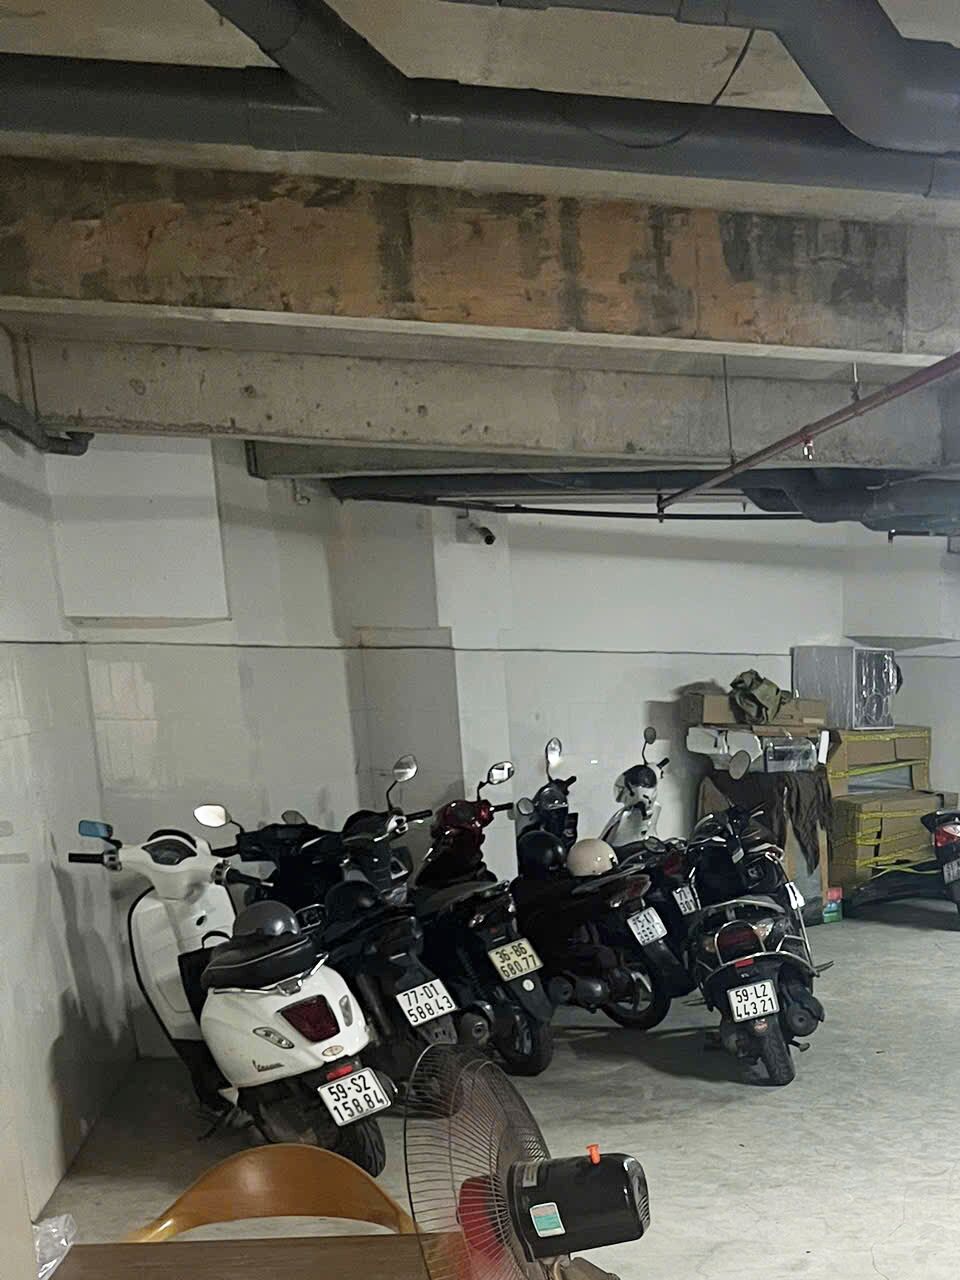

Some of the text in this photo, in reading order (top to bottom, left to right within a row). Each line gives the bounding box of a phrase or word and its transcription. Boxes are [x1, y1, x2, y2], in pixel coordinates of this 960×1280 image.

[495, 942, 528, 963] 36-B6
[500, 954, 537, 978] 680.77
[403, 983, 439, 1007] 77-D1
[735, 984, 769, 1003] 59-L2
[407, 995, 453, 1023] 588.43
[328, 1075, 370, 1102] 59-S2
[333, 1090, 384, 1121] 158.84
